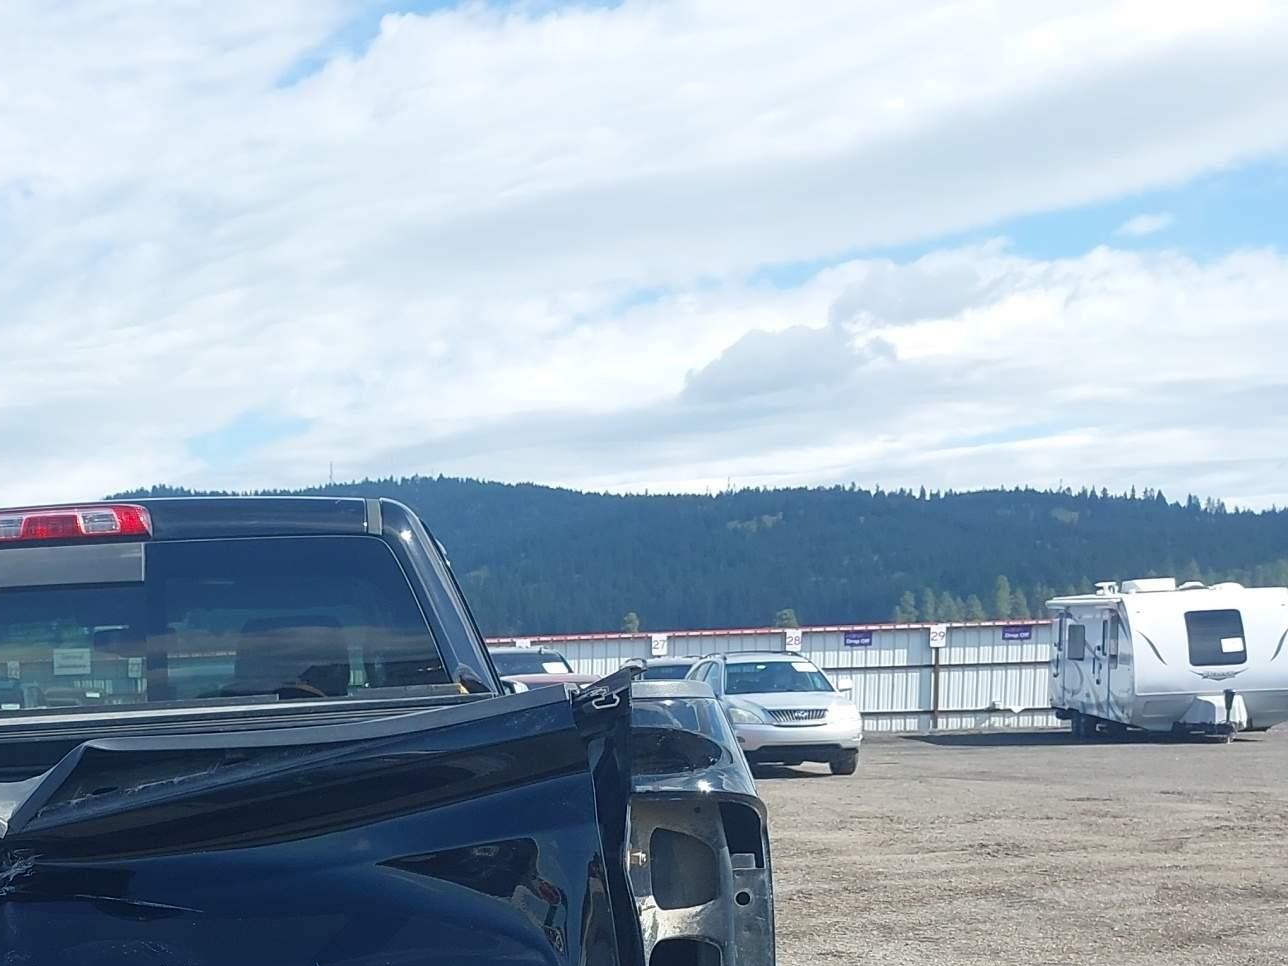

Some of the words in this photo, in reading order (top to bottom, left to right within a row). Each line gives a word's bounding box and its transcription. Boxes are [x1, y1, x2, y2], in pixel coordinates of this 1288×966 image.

[786, 636, 801, 646] 28
[931, 632, 945, 641] 29
[653, 640, 666, 650] 27
